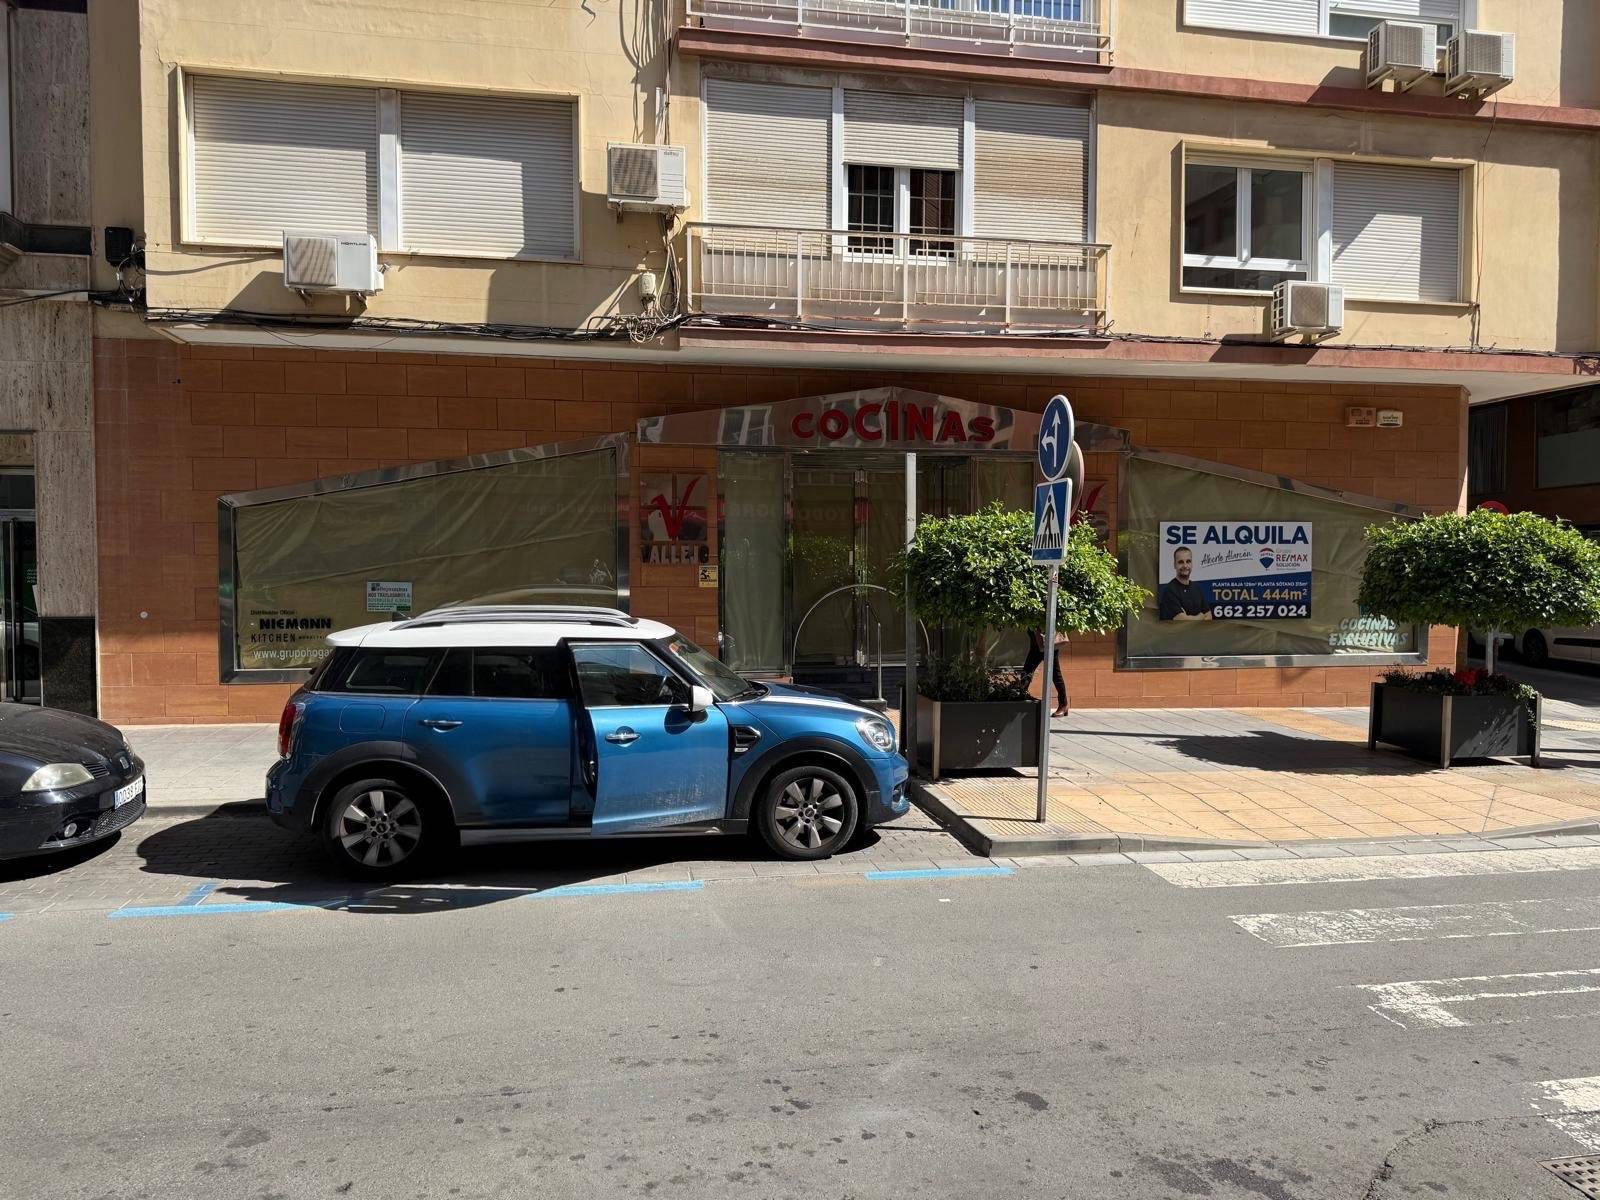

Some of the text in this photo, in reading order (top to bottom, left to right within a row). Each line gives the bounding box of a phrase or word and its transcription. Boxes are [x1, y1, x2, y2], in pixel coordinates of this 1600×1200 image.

[791, 400, 995, 442] COCINAS
[1166, 525, 1309, 545] SE ALQUILA
[1276, 553, 1308, 562] RE/MAX
[1213, 589, 1259, 601] TOTAL
[1213, 605, 1307, 618] 662 257 024
[259, 618, 332, 630] NIEMANN
[1340, 617, 1396, 630] COCINAS
[251, 633, 296, 643] KITCHEN
[1328, 632, 1409, 647] EXCLUSIVAS
